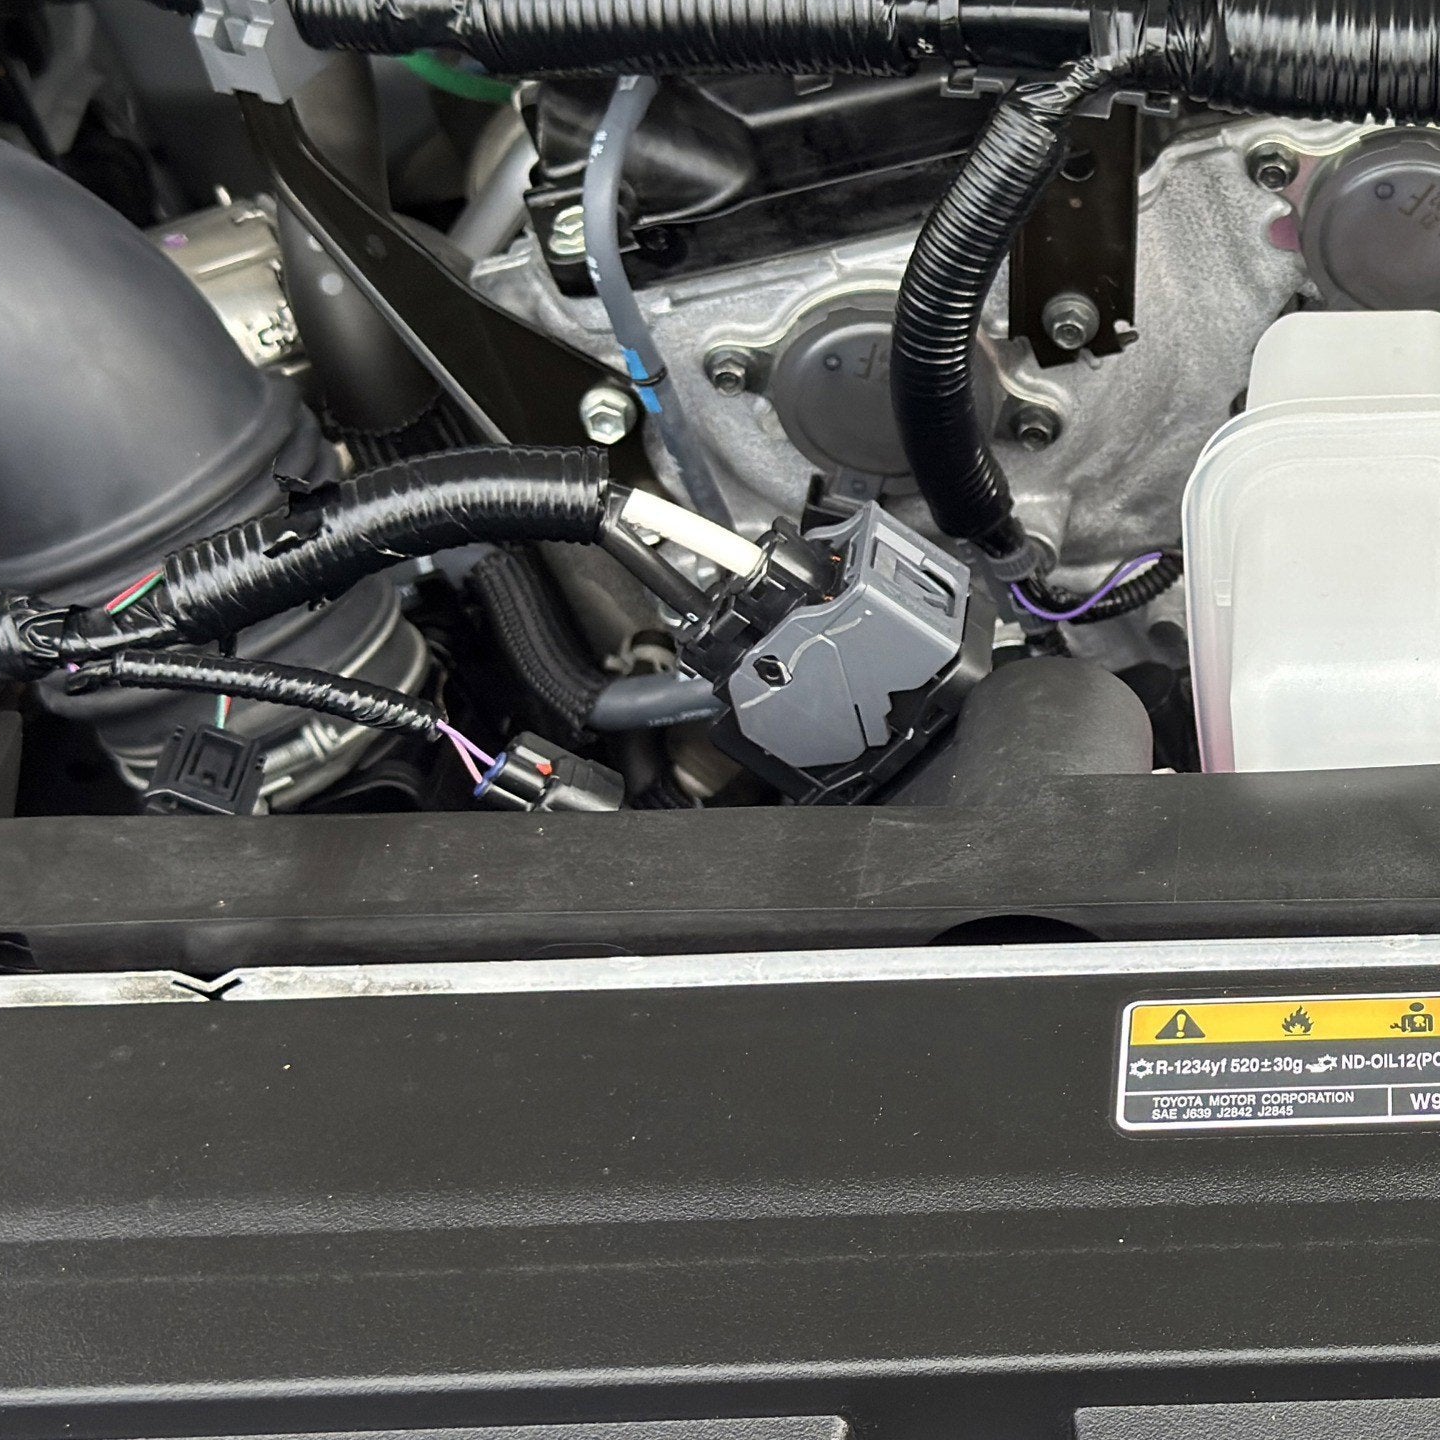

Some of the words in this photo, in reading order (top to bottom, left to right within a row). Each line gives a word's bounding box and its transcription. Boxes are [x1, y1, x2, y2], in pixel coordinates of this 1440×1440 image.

[1155, 1058, 1228, 1077] R-1234yf
[1230, 1056, 1303, 1075] 520±30g
[1152, 1096, 1203, 1108] TOYOTA
[1209, 1094, 1256, 1107] MOTOR
[1261, 1091, 1355, 1105] CORPORATION
[1151, 1109, 1177, 1120] SAE
[1182, 1108, 1211, 1120] J639
[1216, 1107, 1253, 1119] J2842
[1257, 1105, 1294, 1117] J2845
